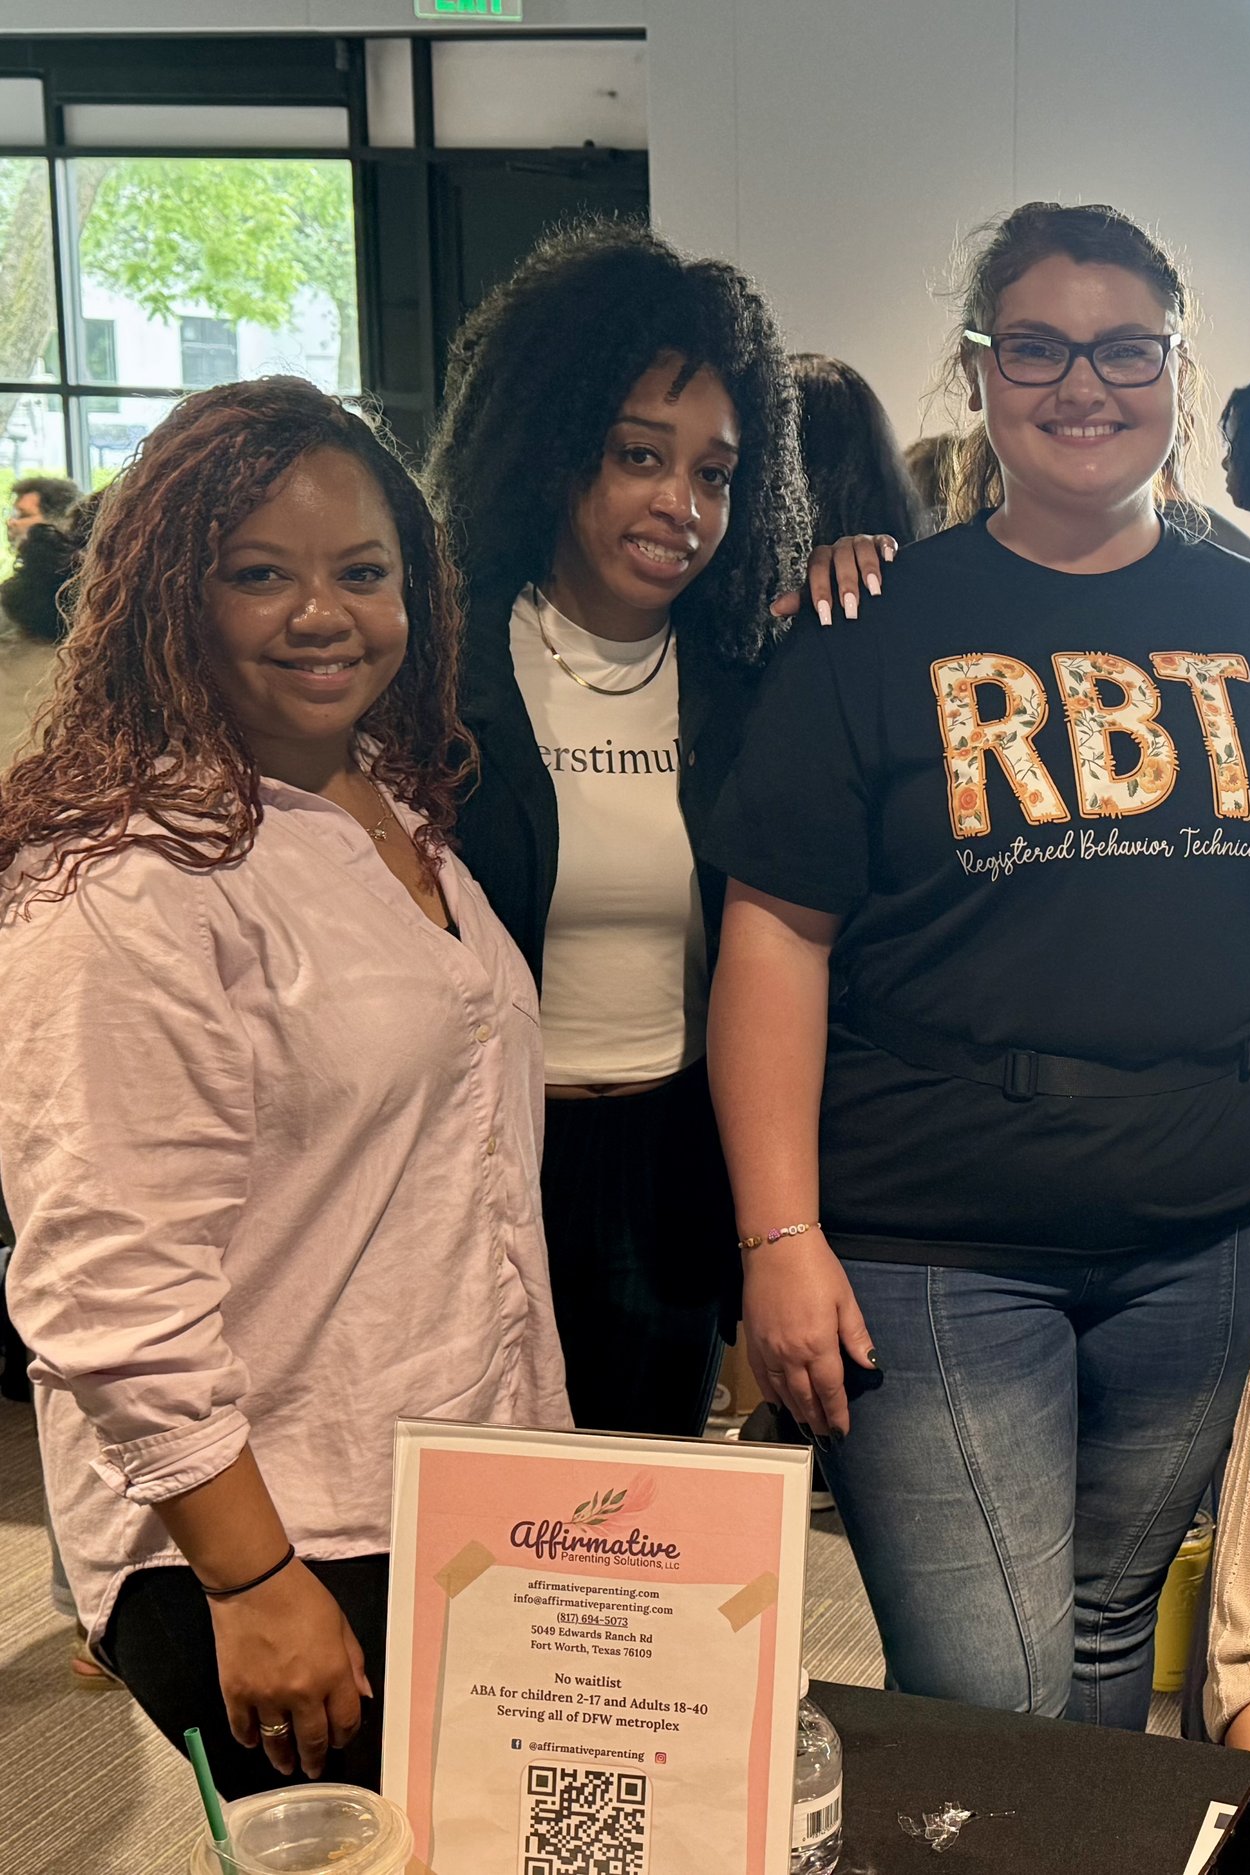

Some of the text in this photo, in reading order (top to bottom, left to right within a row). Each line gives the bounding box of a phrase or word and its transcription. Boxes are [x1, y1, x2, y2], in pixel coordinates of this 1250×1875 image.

[956, 831, 1075, 882] Registered
[1079, 829, 1174, 860] Behavior
[510, 1519, 681, 1560] Affirmative
[561, 1552, 680, 1570] Parenting Solutions, LLC
[528, 1580, 660, 1599] affirmativeparenting.com
[513, 1593, 673, 1615] info@affirmativeparenting.com
[557, 1612, 629, 1628] (817) 694-5073
[531, 1625, 653, 1644] 5049 Edwards Ranch Rd
[530, 1640, 652, 1658] Fort Worth, Texas 76109
[554, 1672, 622, 1689] No waitlist
[470, 1684, 708, 1715] ABA for children 2-17 and Adults 18-40
[497, 1705, 680, 1733] Serving all of DFW metroplex
[529, 1741, 645, 1763] @affirmativeparenting
